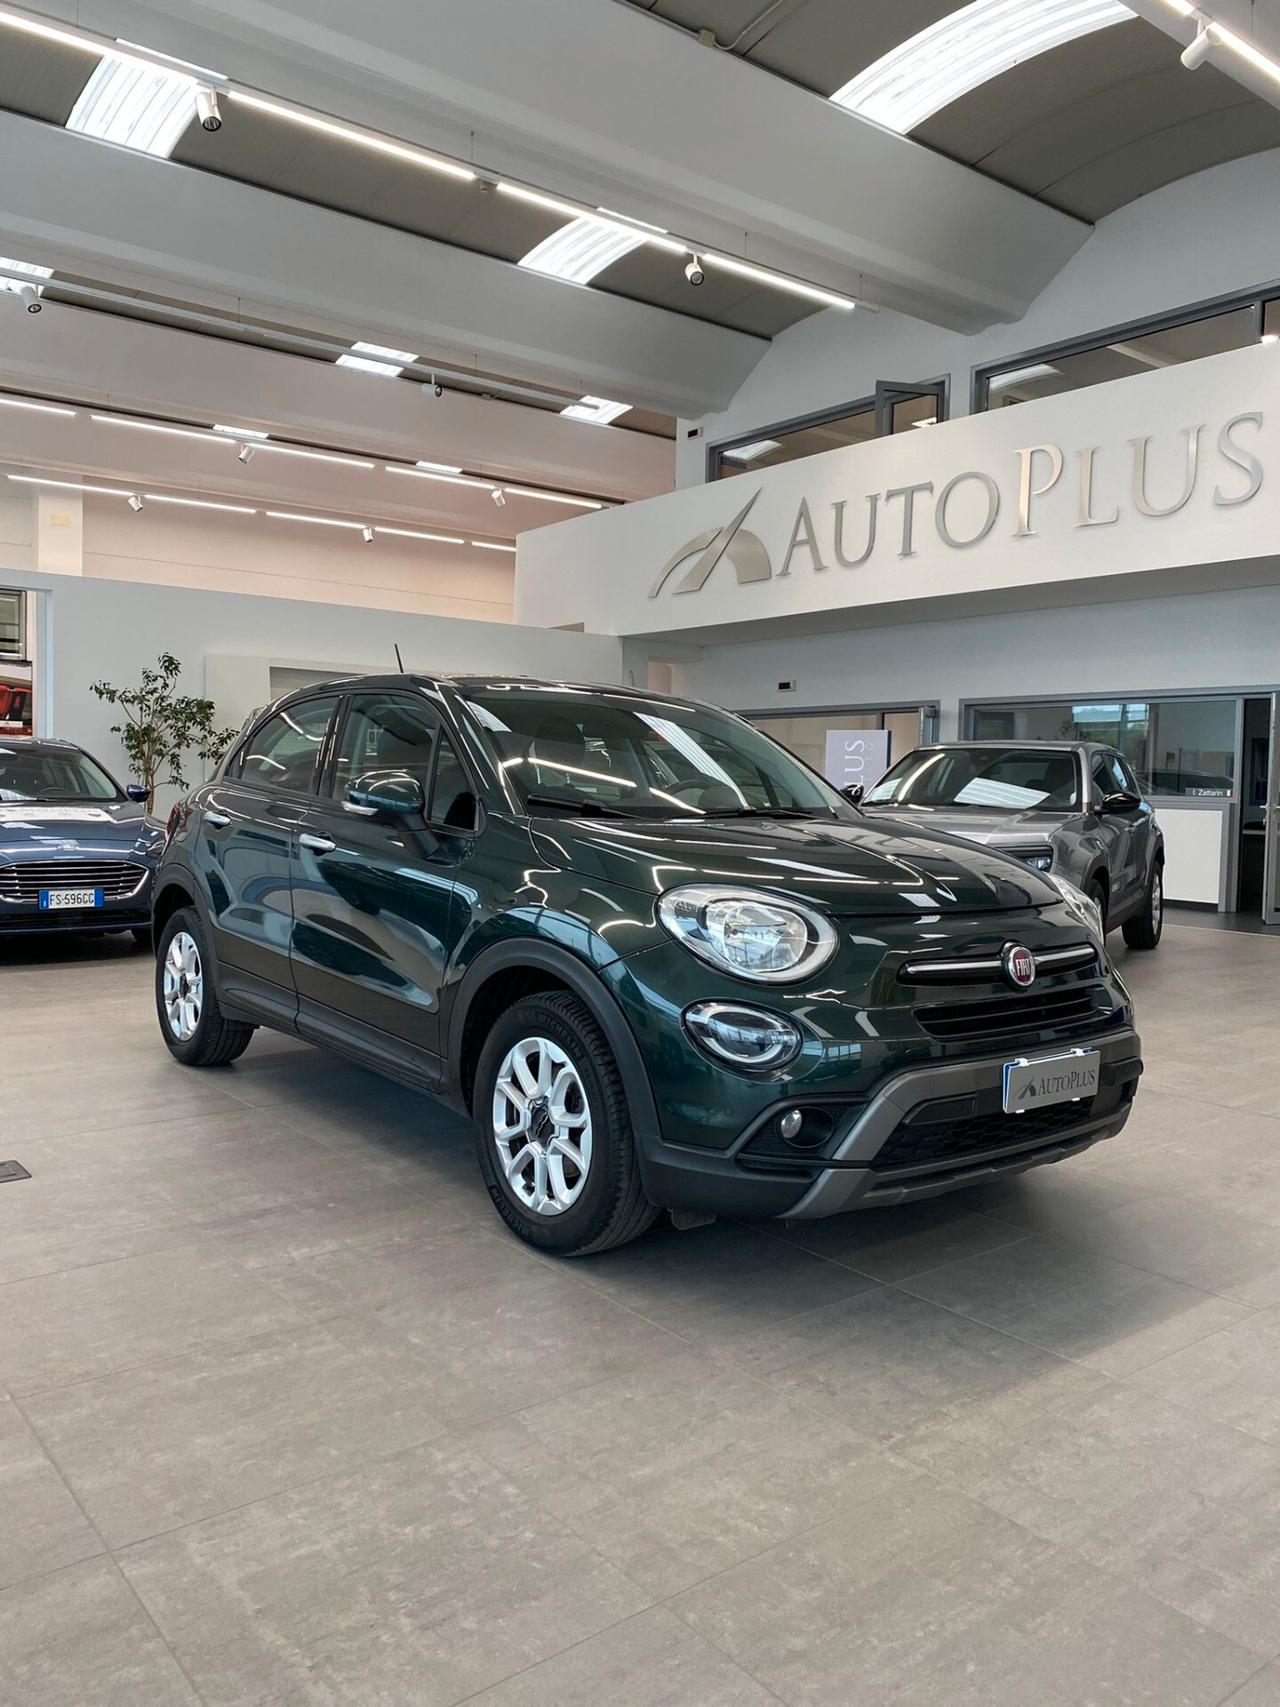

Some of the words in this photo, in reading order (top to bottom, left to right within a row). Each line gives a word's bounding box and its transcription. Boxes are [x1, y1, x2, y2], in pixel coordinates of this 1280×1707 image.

[775, 410, 1264, 577] AUTOPLUS
[1015, 958, 1031, 977] FIAT
[1037, 1069, 1096, 1096] AUTOPLUS
